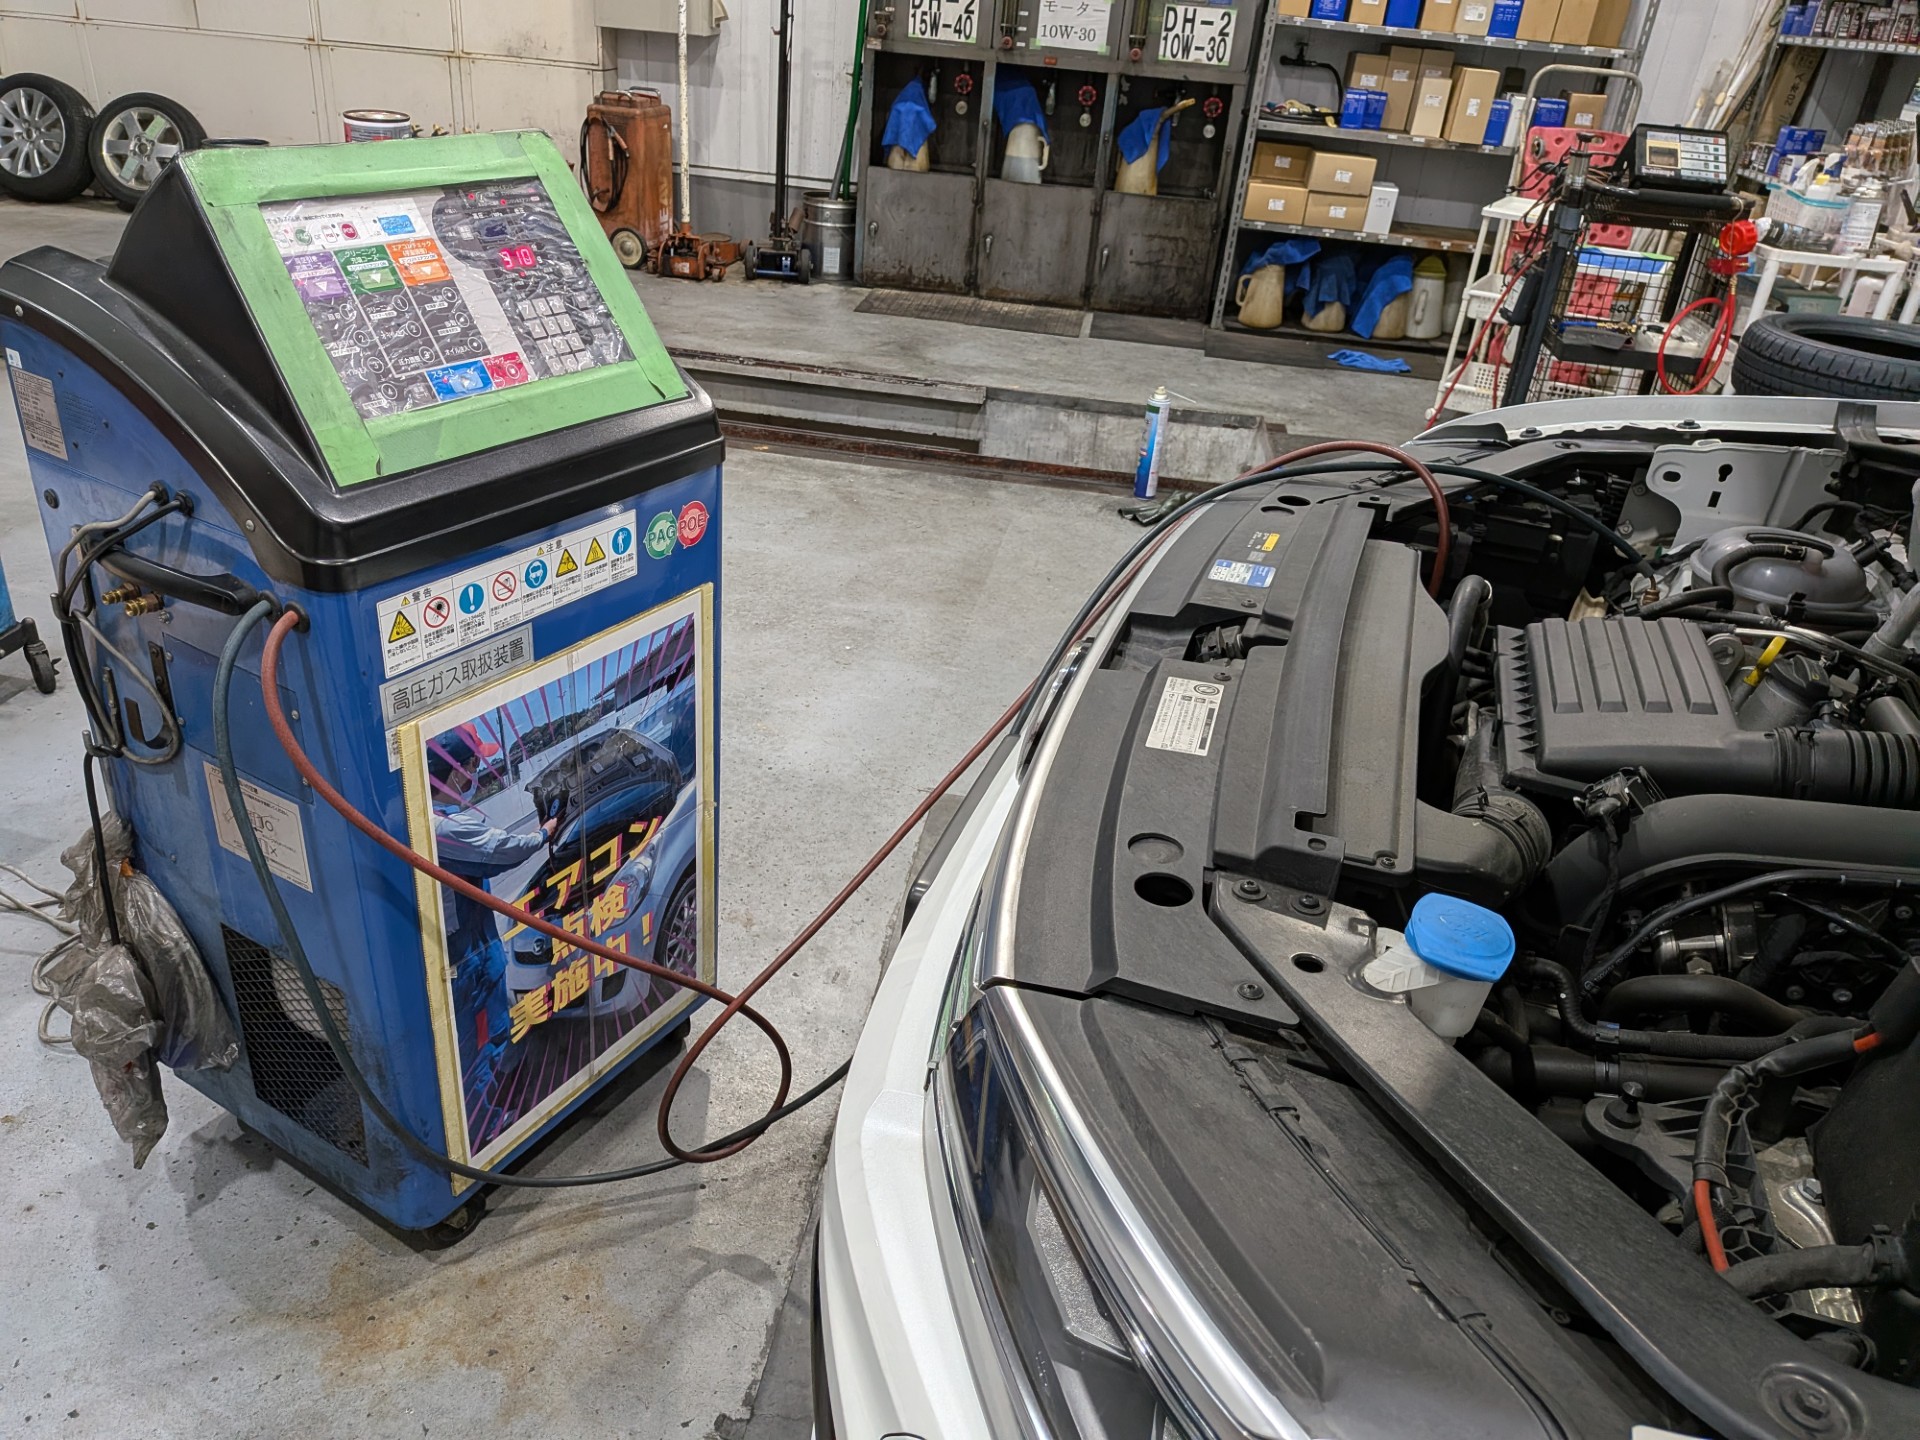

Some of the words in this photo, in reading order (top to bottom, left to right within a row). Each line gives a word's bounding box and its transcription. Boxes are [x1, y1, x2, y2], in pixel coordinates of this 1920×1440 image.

[1042, 1, 1106, 17] モーター
[1165, 6, 1231, 38] DH-2
[911, 10, 974, 40] 15W-40
[1040, 24, 1097, 42] 10W-30
[1162, 33, 1227, 63] 10W-30
[343, 248, 378, 257] クリーニング
[431, 368, 456, 378] スタート
[648, 526, 676, 546] PAG
[677, 513, 708, 533] POE
[546, 539, 563, 553] 注意
[411, 587, 433, 603] 警告
[390, 636, 526, 715] 高圧ガス取扱装置
[503, 816, 662, 942] エアコン
[550, 881, 629, 966] 点検
